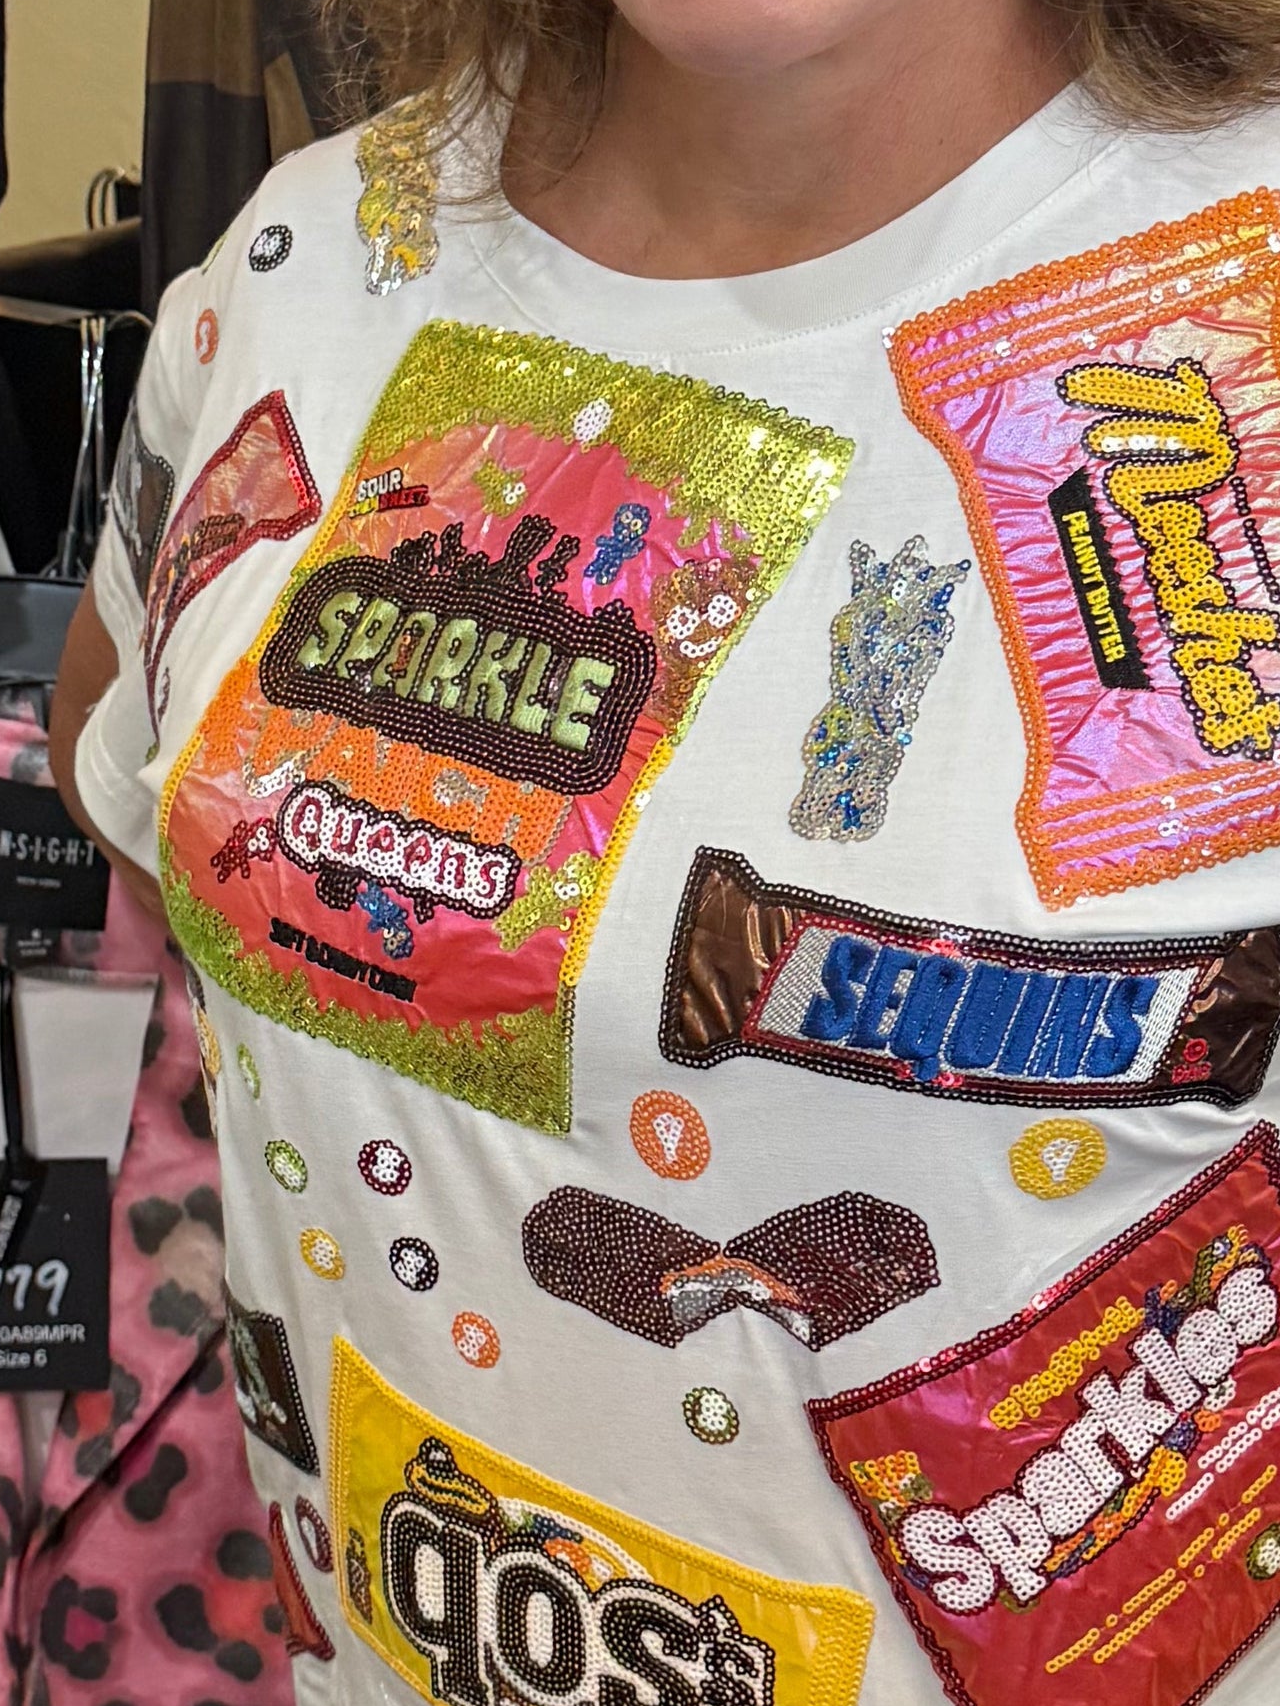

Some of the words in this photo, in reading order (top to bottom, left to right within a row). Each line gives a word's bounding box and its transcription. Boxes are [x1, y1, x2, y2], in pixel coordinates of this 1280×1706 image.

[357, 468, 403, 502] SOUR
[1062, 510, 1106, 585] PEANUT
[1085, 585, 1126, 664] BUTTER
[296, 587, 616, 753] SPARKLE
[287, 791, 508, 903] Queens
[800, 933, 1158, 1081] SEQUINS
[33, 1347, 48, 1368] 6
